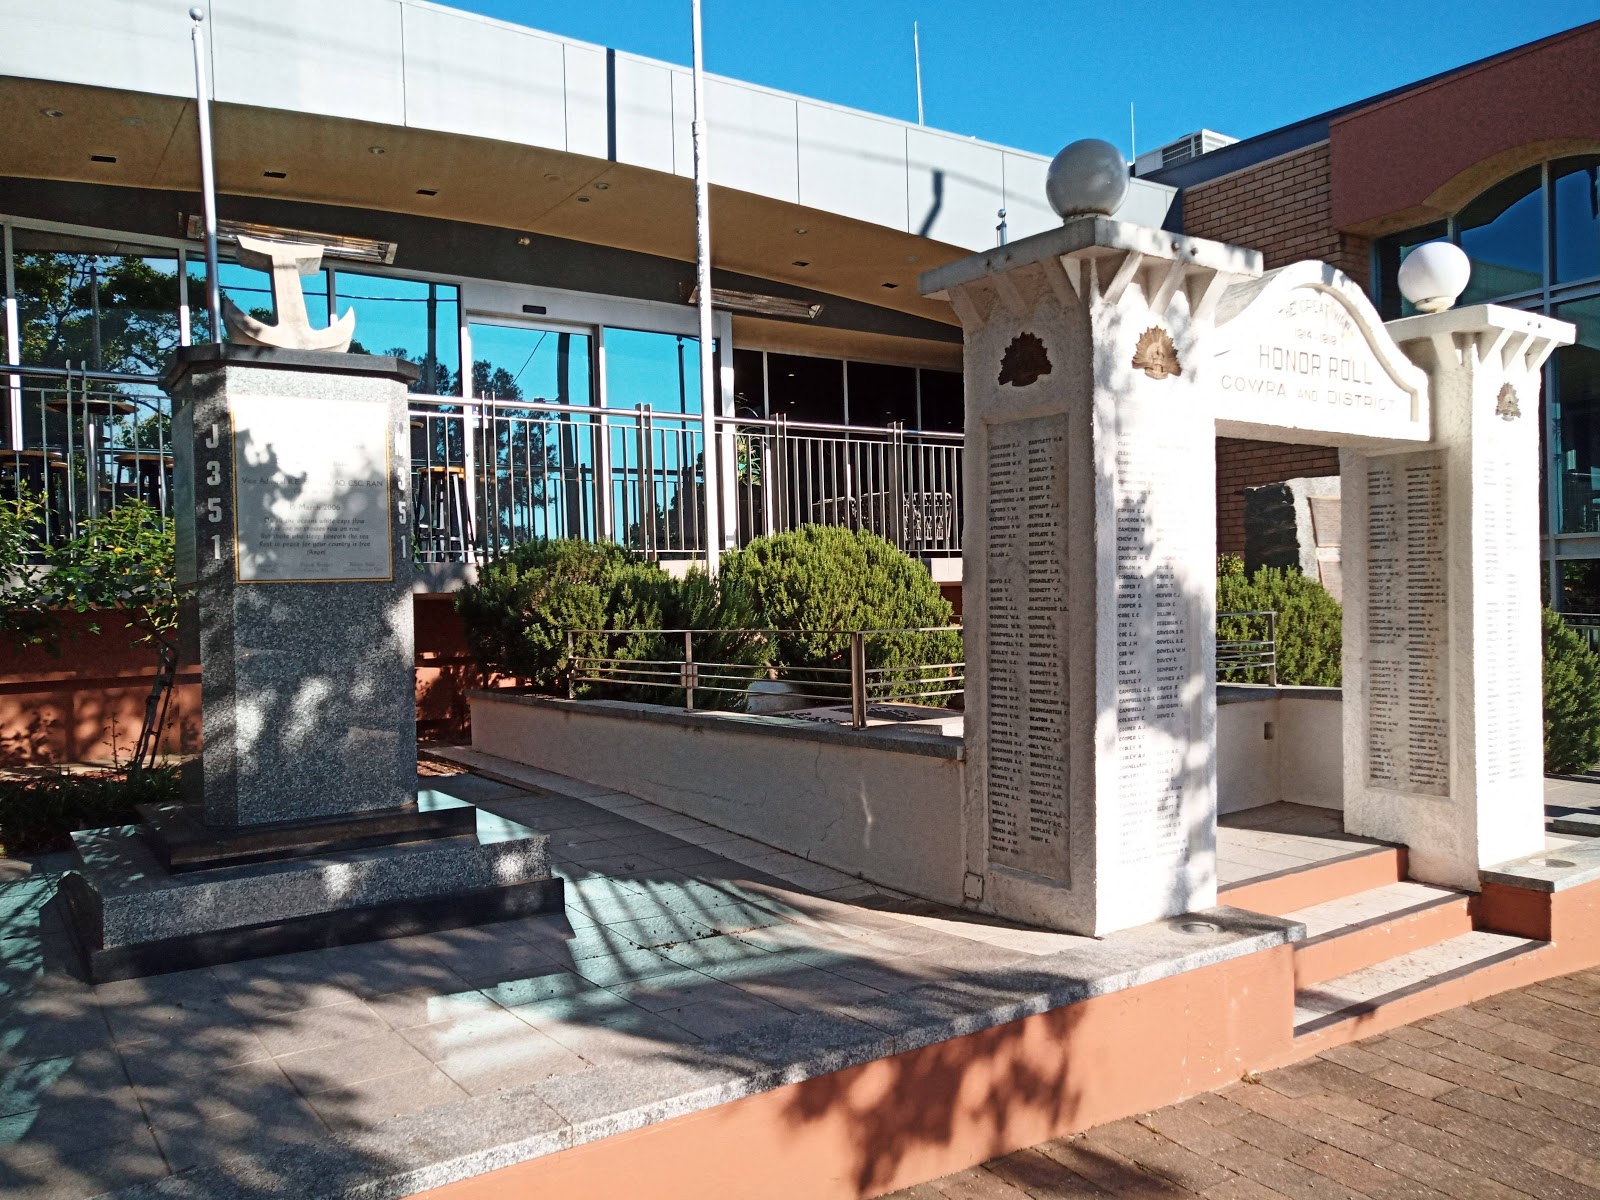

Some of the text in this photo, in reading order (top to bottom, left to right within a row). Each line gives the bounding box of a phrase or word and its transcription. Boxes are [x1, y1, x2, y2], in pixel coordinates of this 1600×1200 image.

[1299, 299, 1329, 318] GREAT
[1259, 344, 1373, 385] HONOR ROLL
[1221, 374, 1395, 411] COWRA AND DISTRICT
